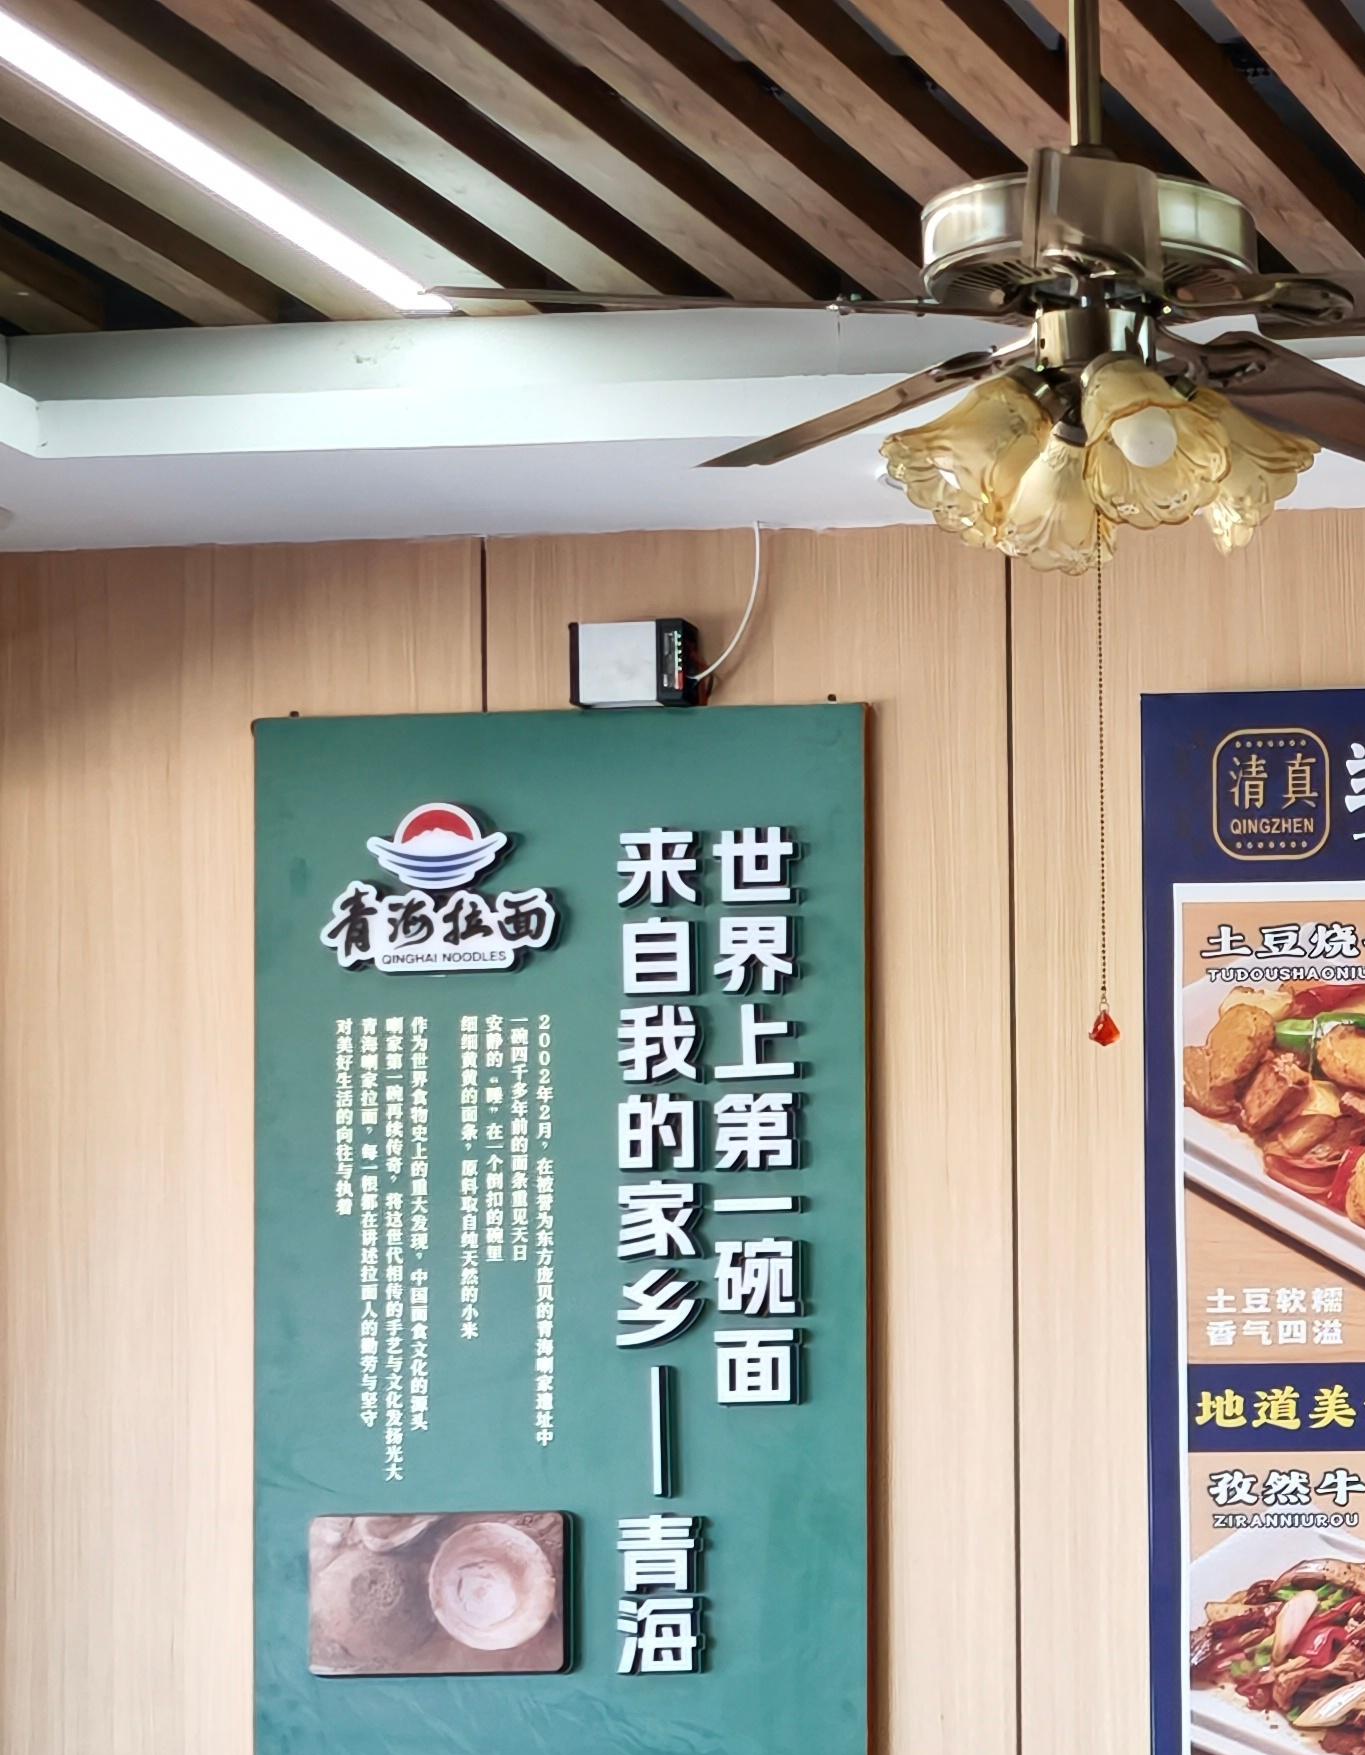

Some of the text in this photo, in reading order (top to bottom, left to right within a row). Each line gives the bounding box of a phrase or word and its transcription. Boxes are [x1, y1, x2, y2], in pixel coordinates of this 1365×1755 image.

[1229, 753, 1318, 810] 清真
[1230, 817, 1314, 835] QINGZHEN
[328, 888, 546, 956] 青海拉面
[383, 951, 506, 965] QINGHAI NOODLES
[712, 826, 796, 1404] 世界上第一碗面
[1206, 1287, 1344, 1315] 土豆软糯
[1206, 1318, 1344, 1346] 香气四溢
[1213, 1513, 1360, 1529] ZIRANNIUROU
